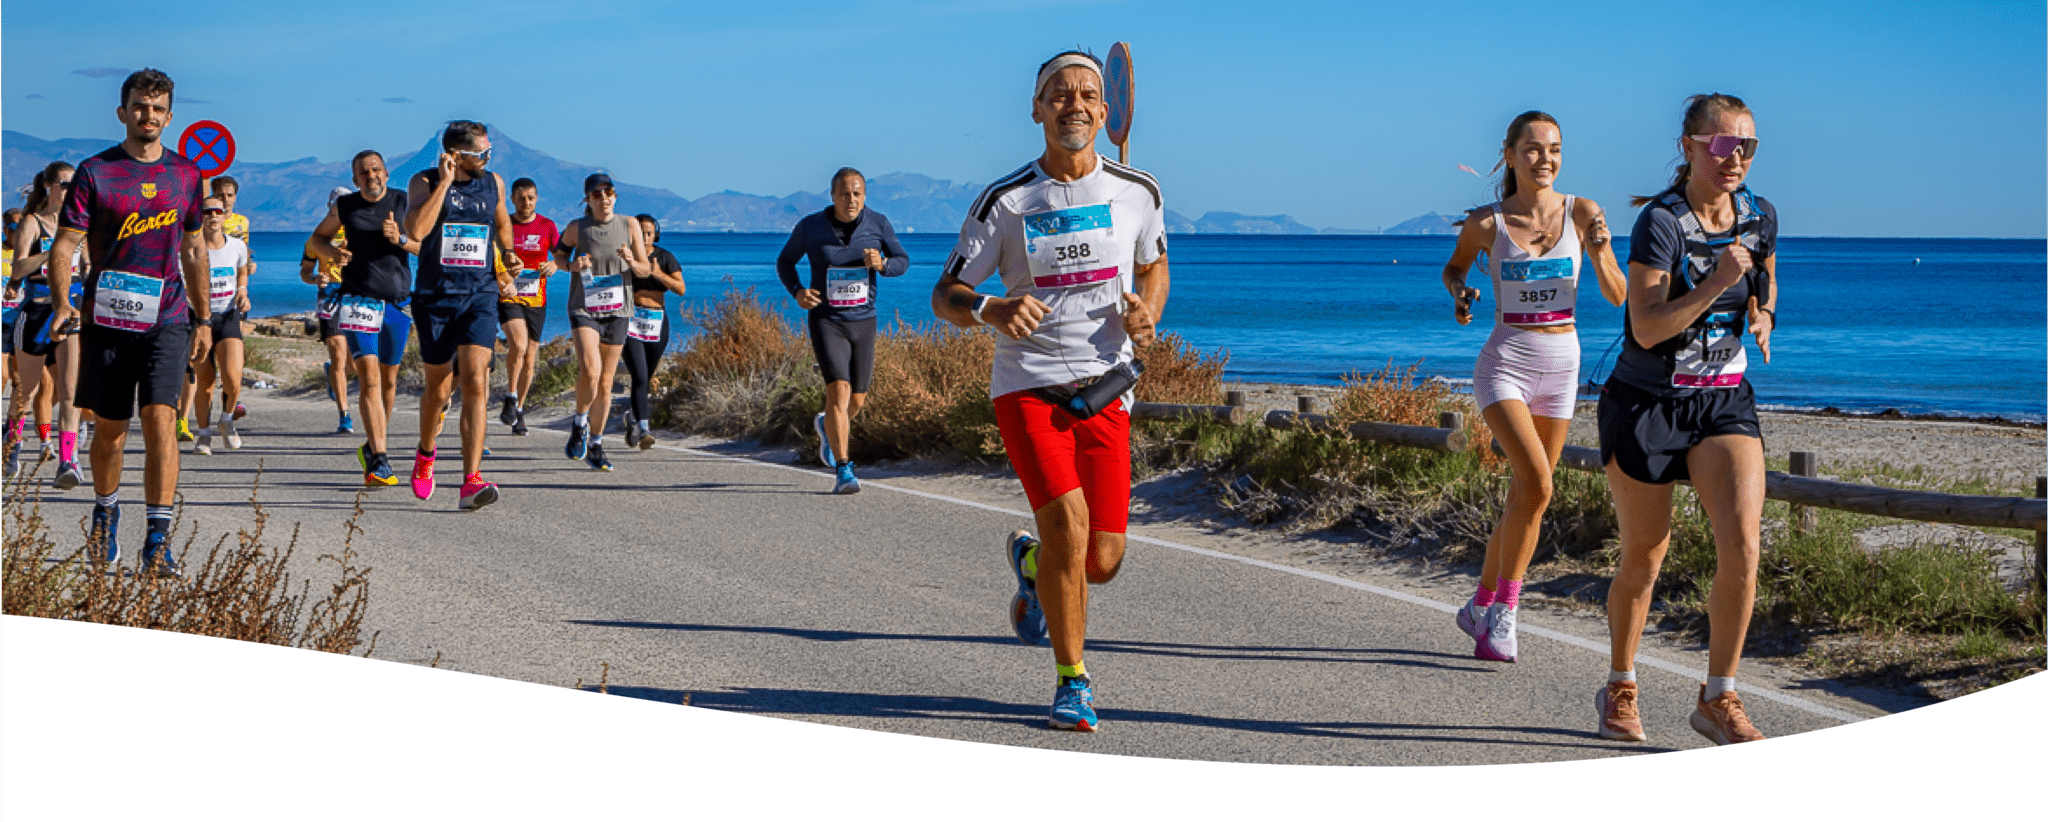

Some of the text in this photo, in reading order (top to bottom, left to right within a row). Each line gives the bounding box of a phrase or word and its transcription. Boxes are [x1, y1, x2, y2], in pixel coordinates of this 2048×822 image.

[1055, 243, 1091, 261] 388
[1519, 288, 1557, 302] 3857
[109, 298, 143, 312] 2569
[1704, 348, 1731, 362] 113
